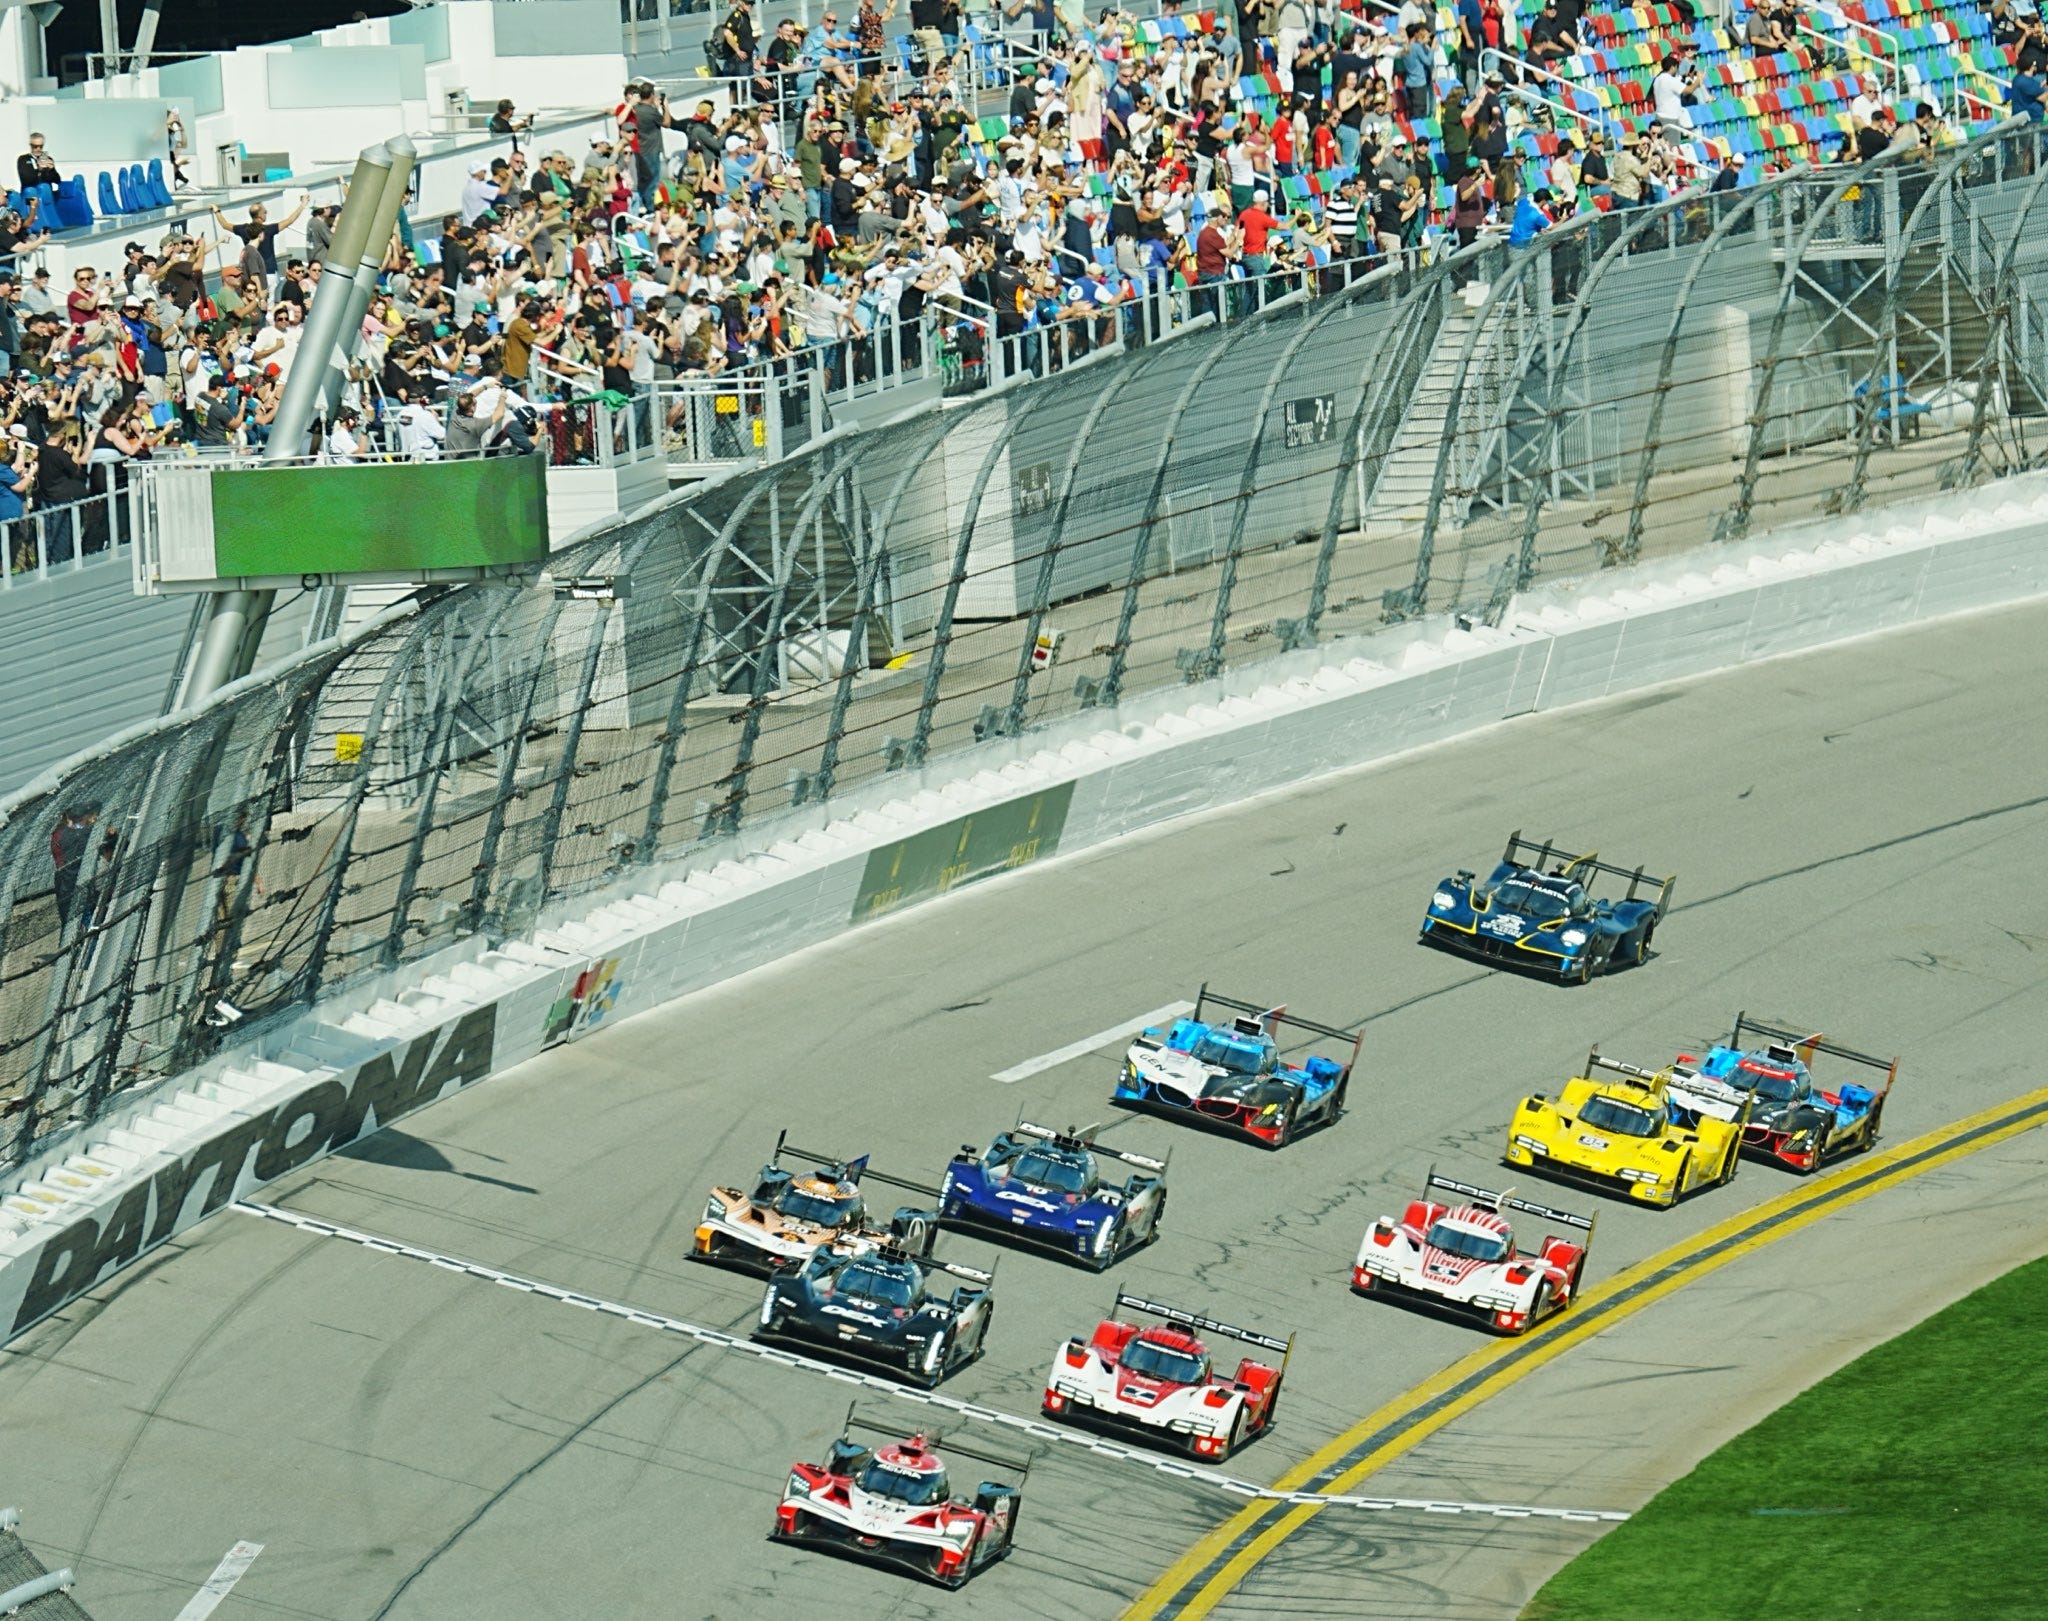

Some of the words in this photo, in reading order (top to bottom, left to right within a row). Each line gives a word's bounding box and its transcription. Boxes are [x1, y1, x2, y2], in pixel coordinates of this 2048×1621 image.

[1505, 879, 1534, 890] ASTON
[1533, 885, 1570, 903] MARTIN
[1138, 1053, 1167, 1072] GEN
[8, 1002, 498, 1335] DAYTONA
[1028, 1151, 1080, 1170] CADILLAC
[794, 1188, 836, 1204] ACURA
[1025, 1183, 1049, 1195] 10
[853, 1263, 906, 1281] CADILLAC
[846, 1298, 878, 1310] 40
[877, 1463, 922, 1480] ACURA
